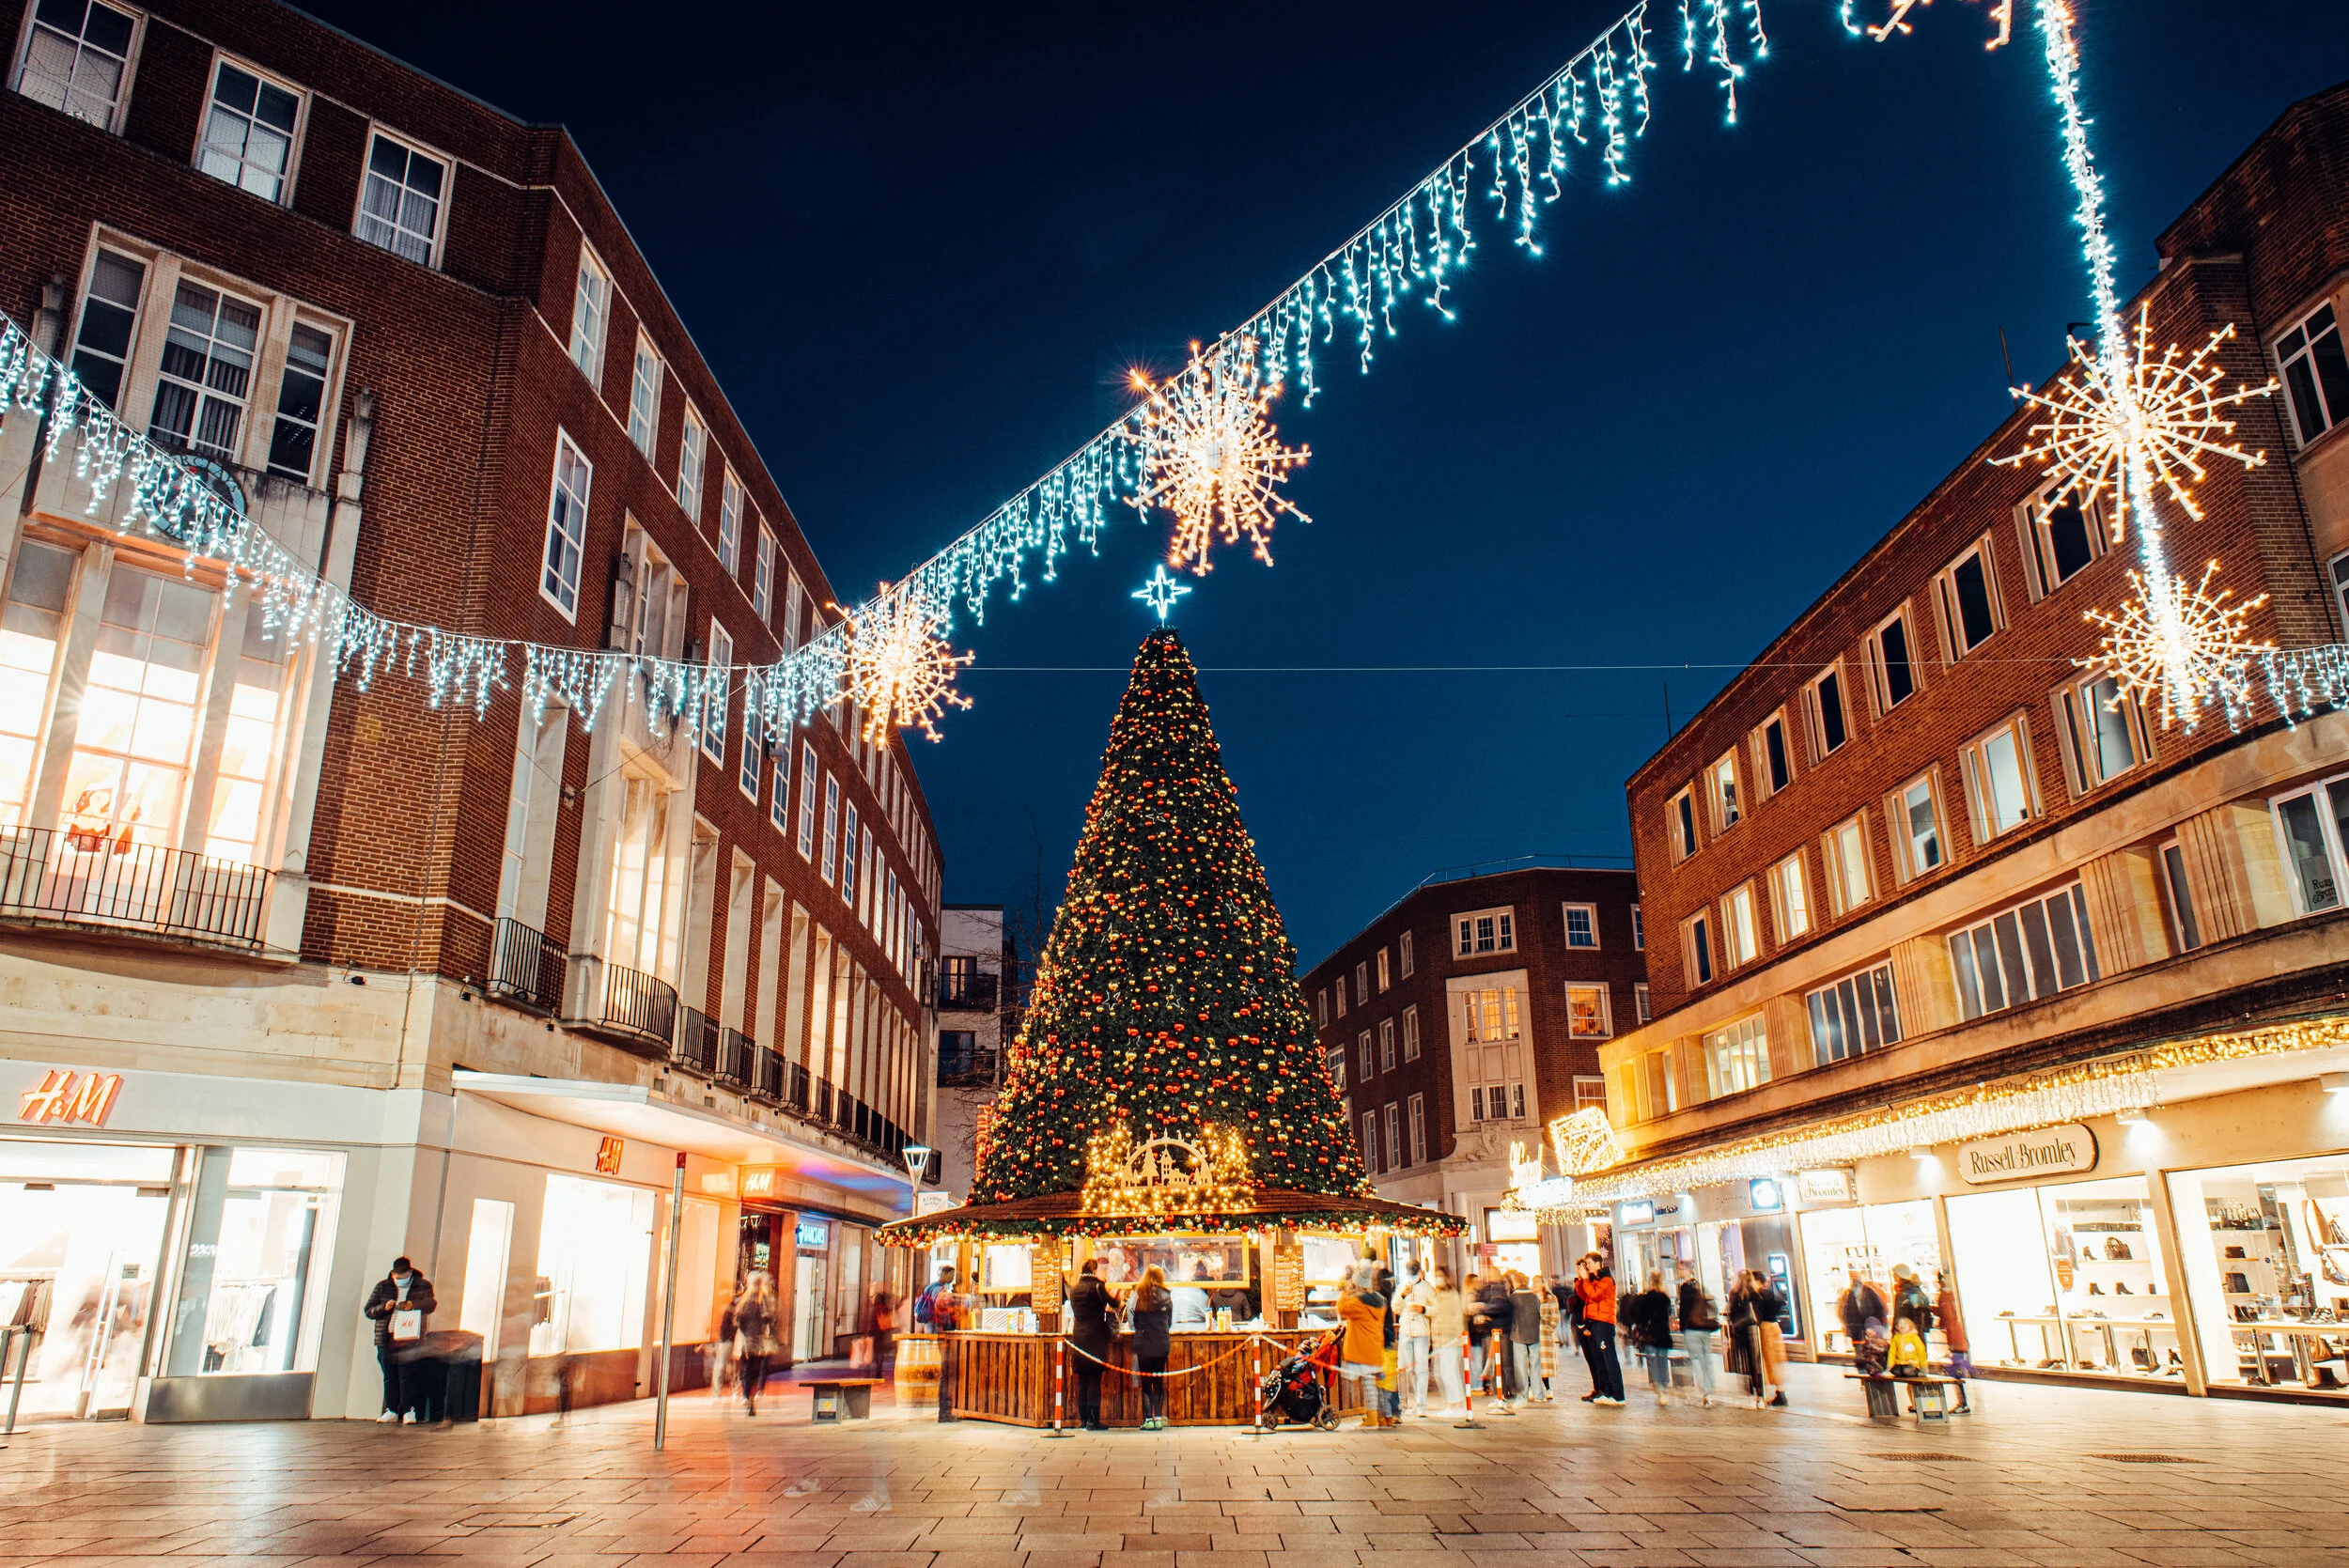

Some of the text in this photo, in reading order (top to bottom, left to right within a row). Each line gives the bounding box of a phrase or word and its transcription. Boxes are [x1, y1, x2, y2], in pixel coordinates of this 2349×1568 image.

[19, 1070, 120, 1126] H&M
[596, 1136, 624, 1174] H&M
[1969, 1145, 2015, 1174] Russell
[2019, 1138, 2076, 1168] Bromley
[745, 1172, 770, 1191] H&M
